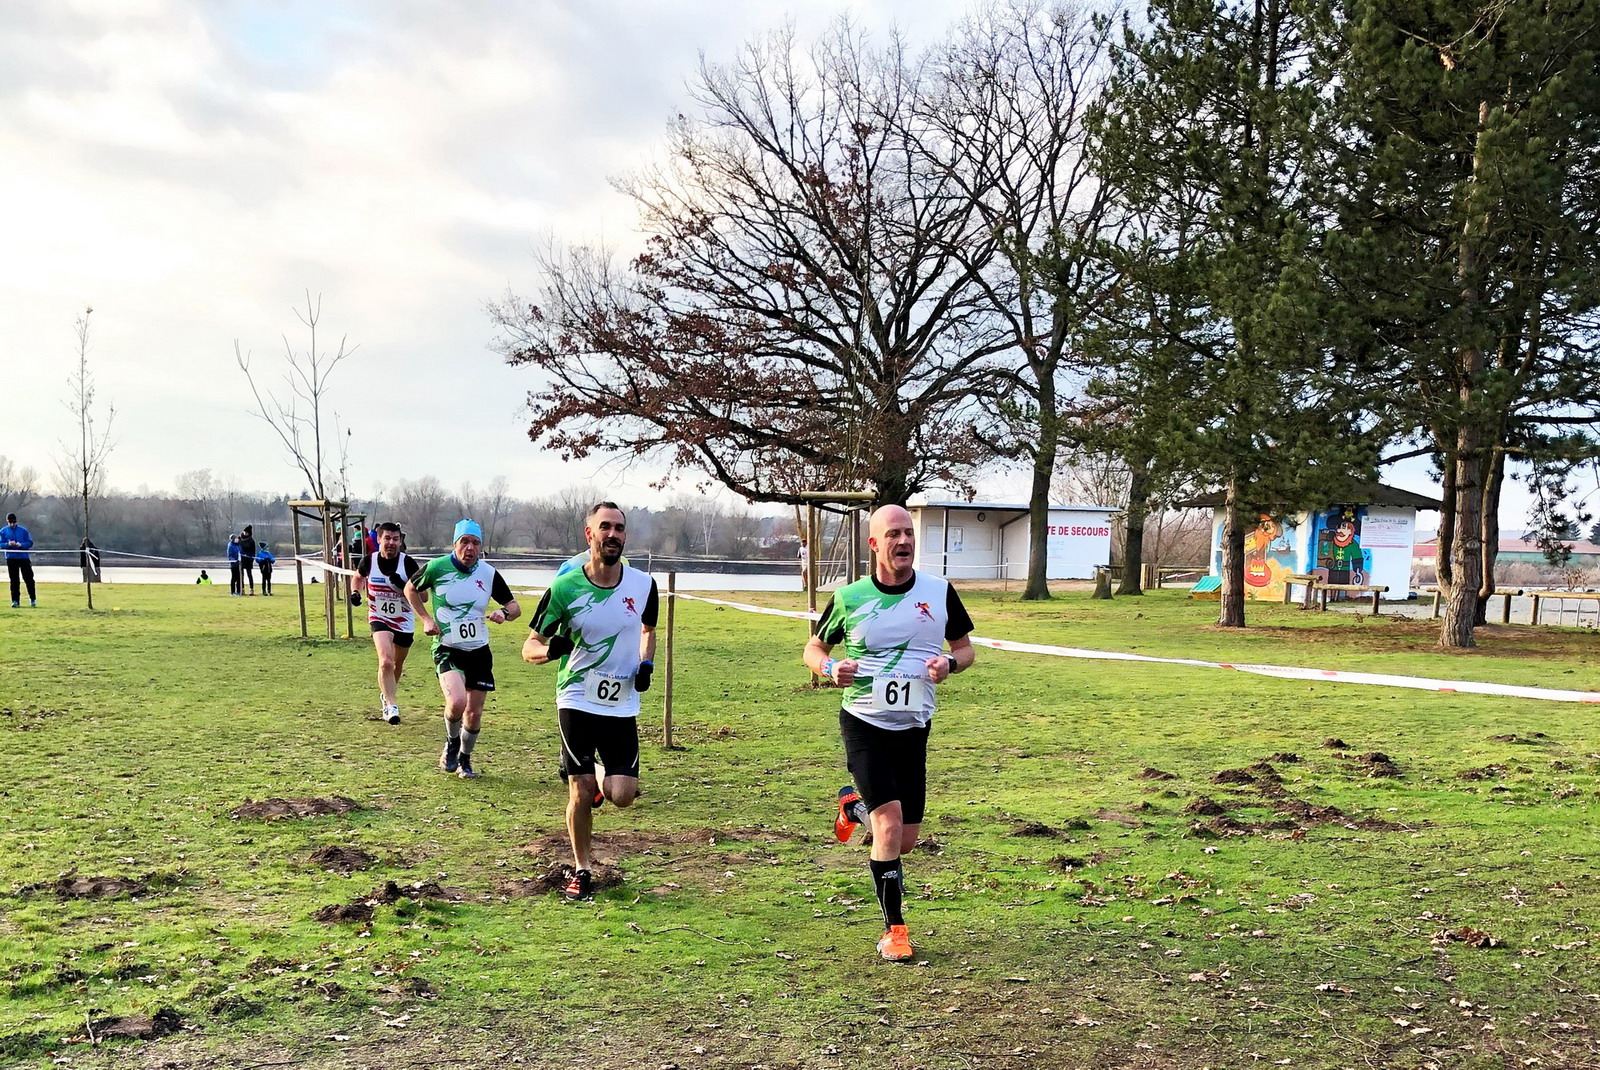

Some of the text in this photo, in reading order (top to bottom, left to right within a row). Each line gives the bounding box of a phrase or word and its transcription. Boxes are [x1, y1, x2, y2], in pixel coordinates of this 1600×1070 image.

[1058, 526, 1069, 536] DE
[1071, 526, 1109, 536] SECOURS
[381, 602, 396, 614] 46
[459, 622, 476, 639] 60
[597, 679, 622, 701] 62
[885, 680, 911, 706] 61
